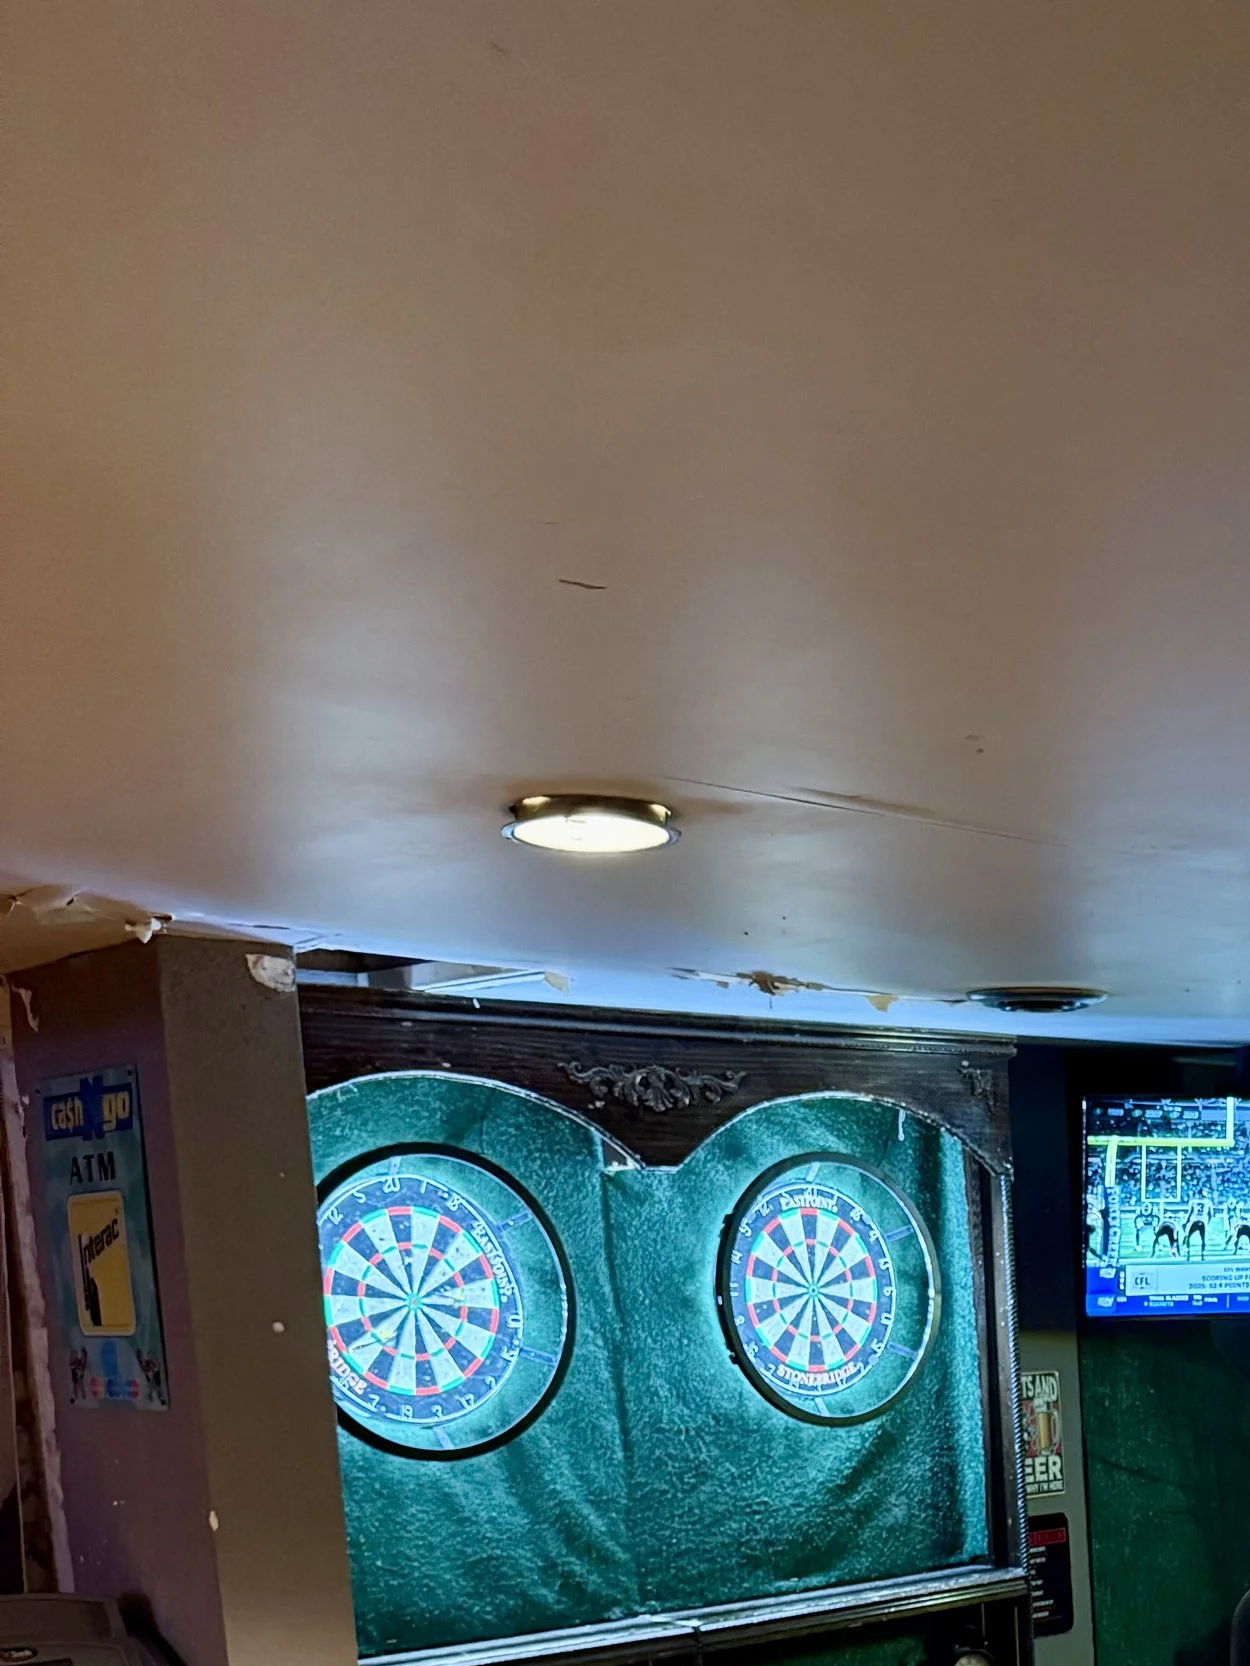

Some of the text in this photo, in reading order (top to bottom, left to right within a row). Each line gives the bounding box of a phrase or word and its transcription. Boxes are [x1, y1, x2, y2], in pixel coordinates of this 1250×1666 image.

[103, 1091, 130, 1131] go
[70, 1151, 116, 1185] ATM
[1134, 1277, 1150, 1286] CFL
[1035, 1375, 1058, 1401] AND
[1024, 1455, 1062, 1482] EER
